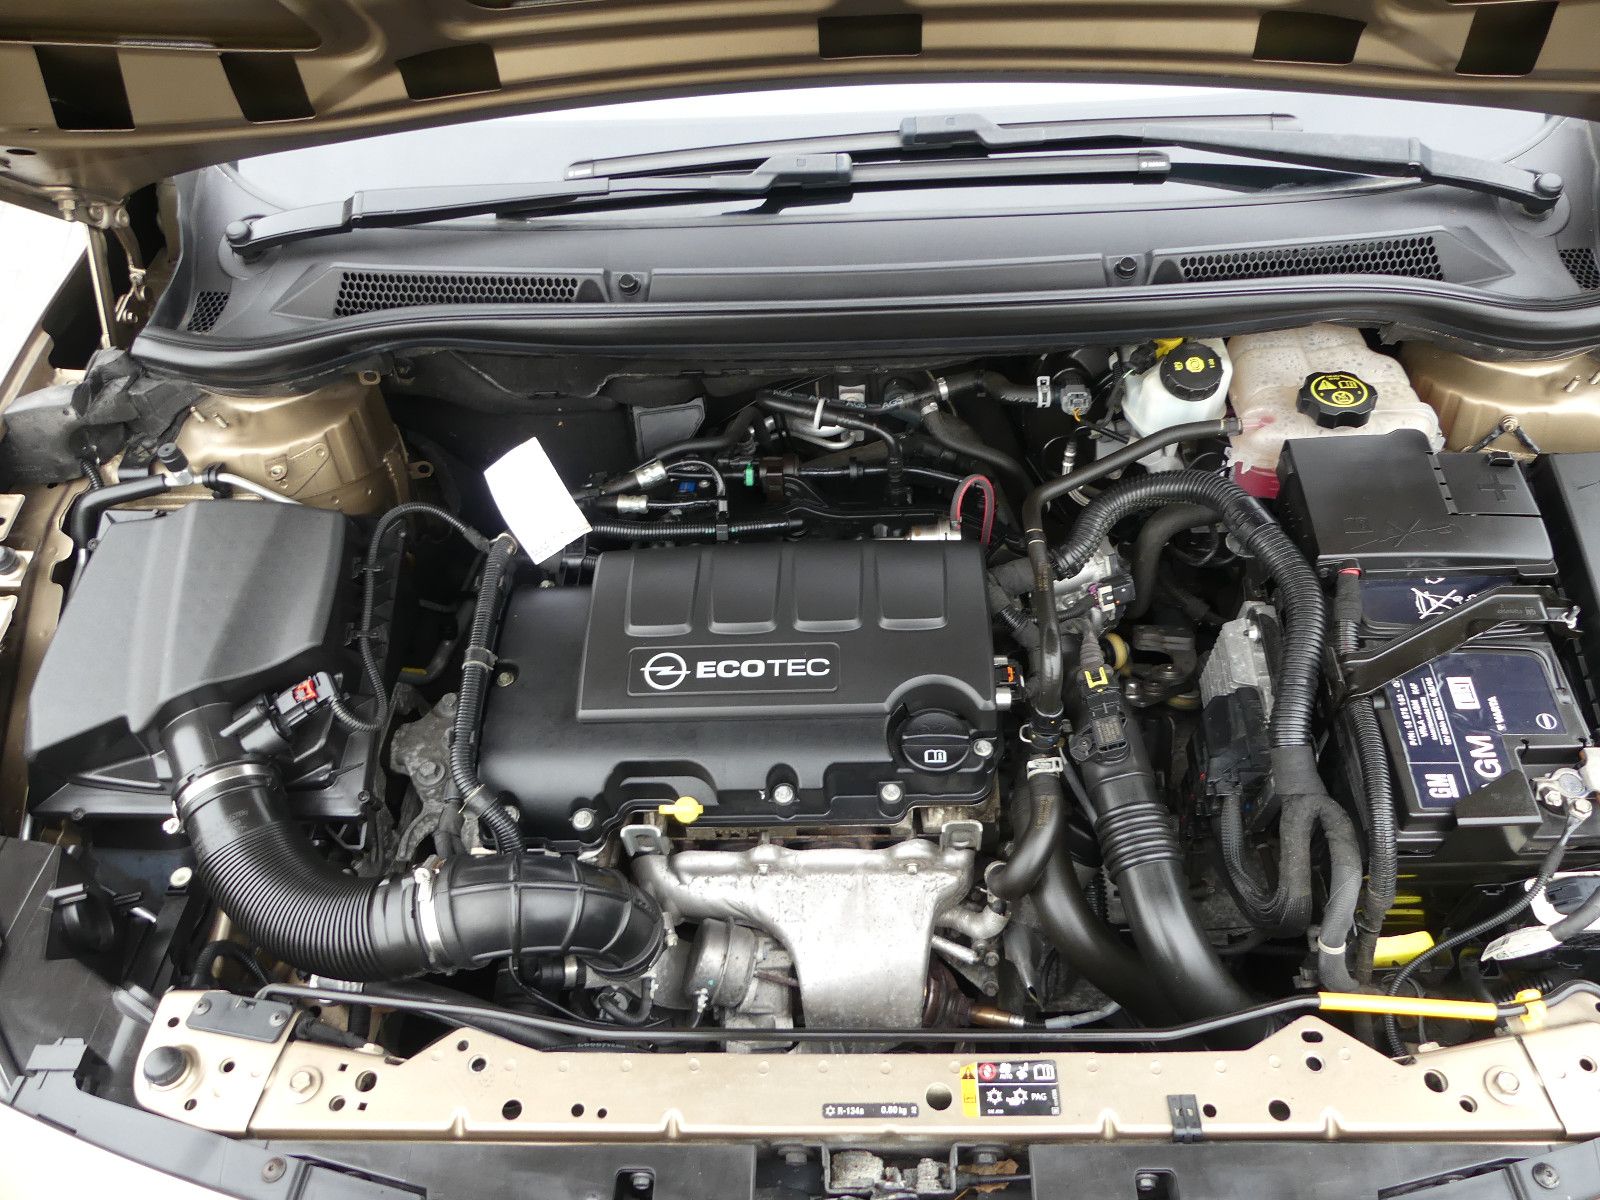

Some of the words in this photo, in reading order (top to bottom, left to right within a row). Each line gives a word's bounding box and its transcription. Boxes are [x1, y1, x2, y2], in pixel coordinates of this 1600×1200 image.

[696, 658, 831, 679] ECOTEC
[1424, 773, 1457, 799] GM
[1030, 1092, 1048, 1101] PAG
[837, 1106, 865, 1116] R-134a
